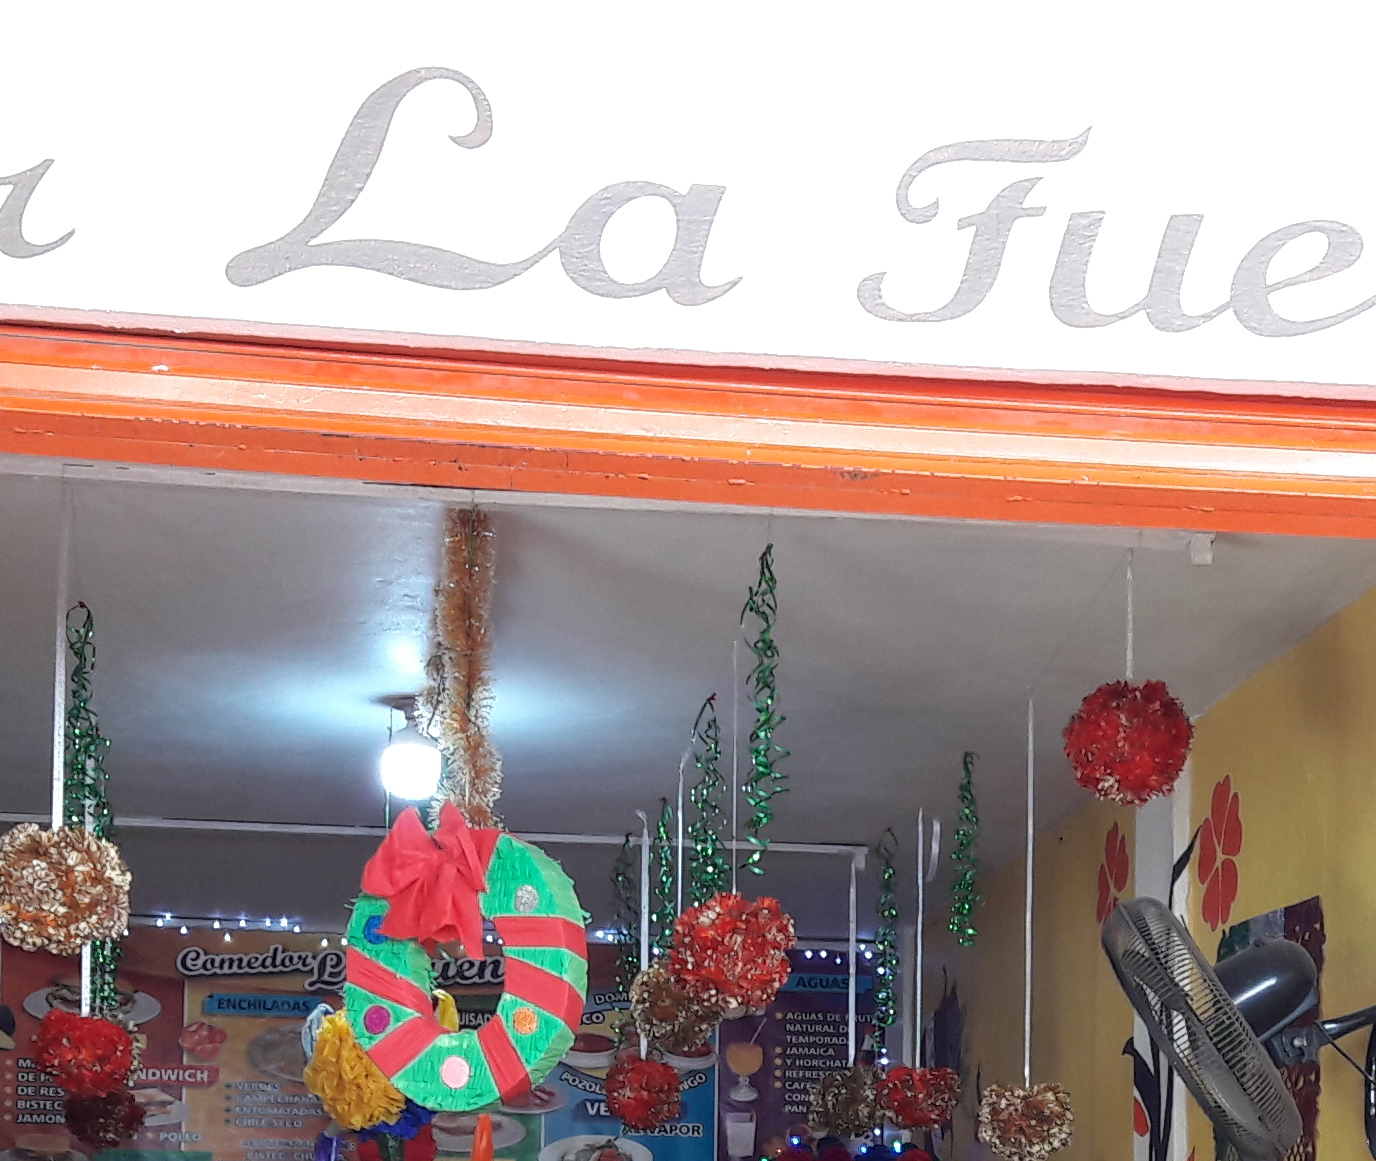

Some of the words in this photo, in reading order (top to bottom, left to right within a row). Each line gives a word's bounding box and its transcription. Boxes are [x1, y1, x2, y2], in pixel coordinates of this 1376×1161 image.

[225, 65, 742, 307] La
[178, 945, 312, 974] Comedor
[217, 998, 309, 1011] ENCHILADAS
[785, 1011, 824, 1021] AGUAS
[785, 1023, 836, 1033] NATURAL
[785, 1034, 850, 1045] TEMPORAD
[785, 1047, 835, 1056] JAMAICA
[784, 1058, 792, 1067] Y
[795, 1058, 848, 1068] HORCHAT
[17, 1071, 36, 1083] DE
[17, 1086, 36, 1096] DE
[39, 1087, 66, 1098] RES
[16, 1099, 63, 1111] BISTEC
[784, 1104, 807, 1114] PAN
[16, 1113, 66, 1125] JAMON
[159, 1132, 202, 1142] POLLO
